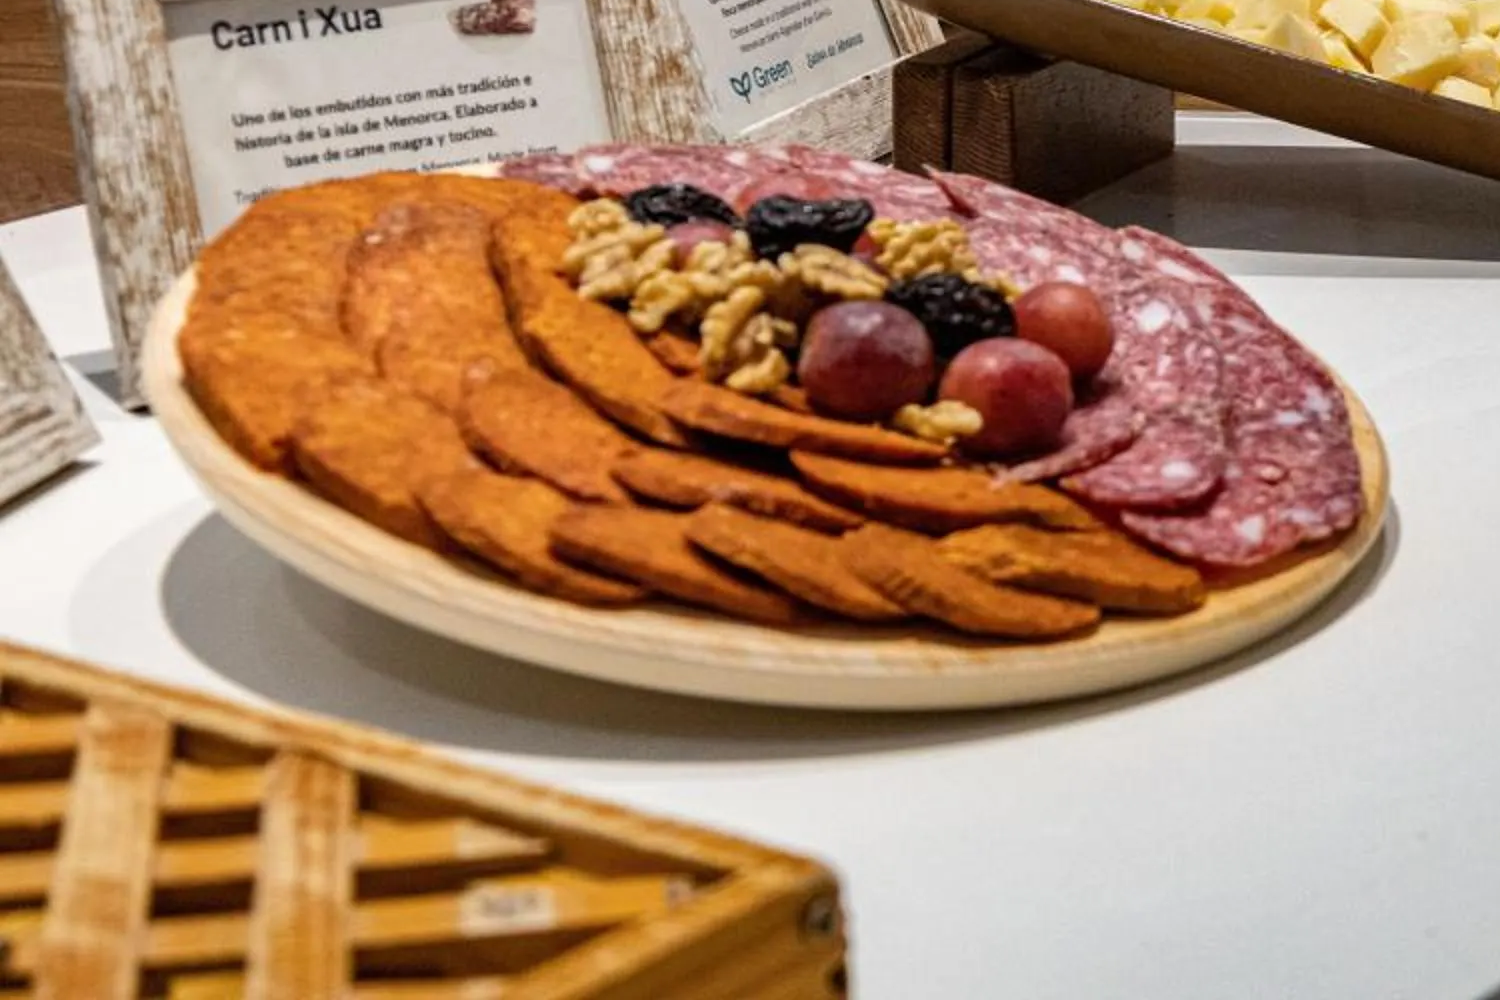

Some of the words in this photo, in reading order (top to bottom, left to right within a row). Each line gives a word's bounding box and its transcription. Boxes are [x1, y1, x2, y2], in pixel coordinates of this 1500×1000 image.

[211, 20, 293, 51] Carn
[298, 9, 309, 40] i
[315, 4, 383, 38] Xua
[752, 60, 793, 88] Green
[231, 112, 265, 128] Uno
[267, 109, 286, 123] de
[288, 105, 312, 119] los
[315, 94, 392, 116] embutidos
[395, 91, 422, 104] con
[425, 85, 454, 99] más
[457, 74, 520, 95] tradición
[523, 74, 532, 86] e
[235, 131, 292, 152] historia
[296, 129, 314, 142] de
[318, 125, 331, 139] la
[334, 121, 359, 137] isla
[362, 118, 381, 132] de
[383, 111, 450, 129] Menorca.
[454, 96, 527, 119] Elaborado
[529, 97, 538, 108] a
[284, 151, 319, 169] base
[322, 148, 341, 162] de
[344, 143, 385, 159] carne
[389, 134, 433, 152] magra
[437, 134, 446, 147] y
[448, 126, 497, 143] tocino.
